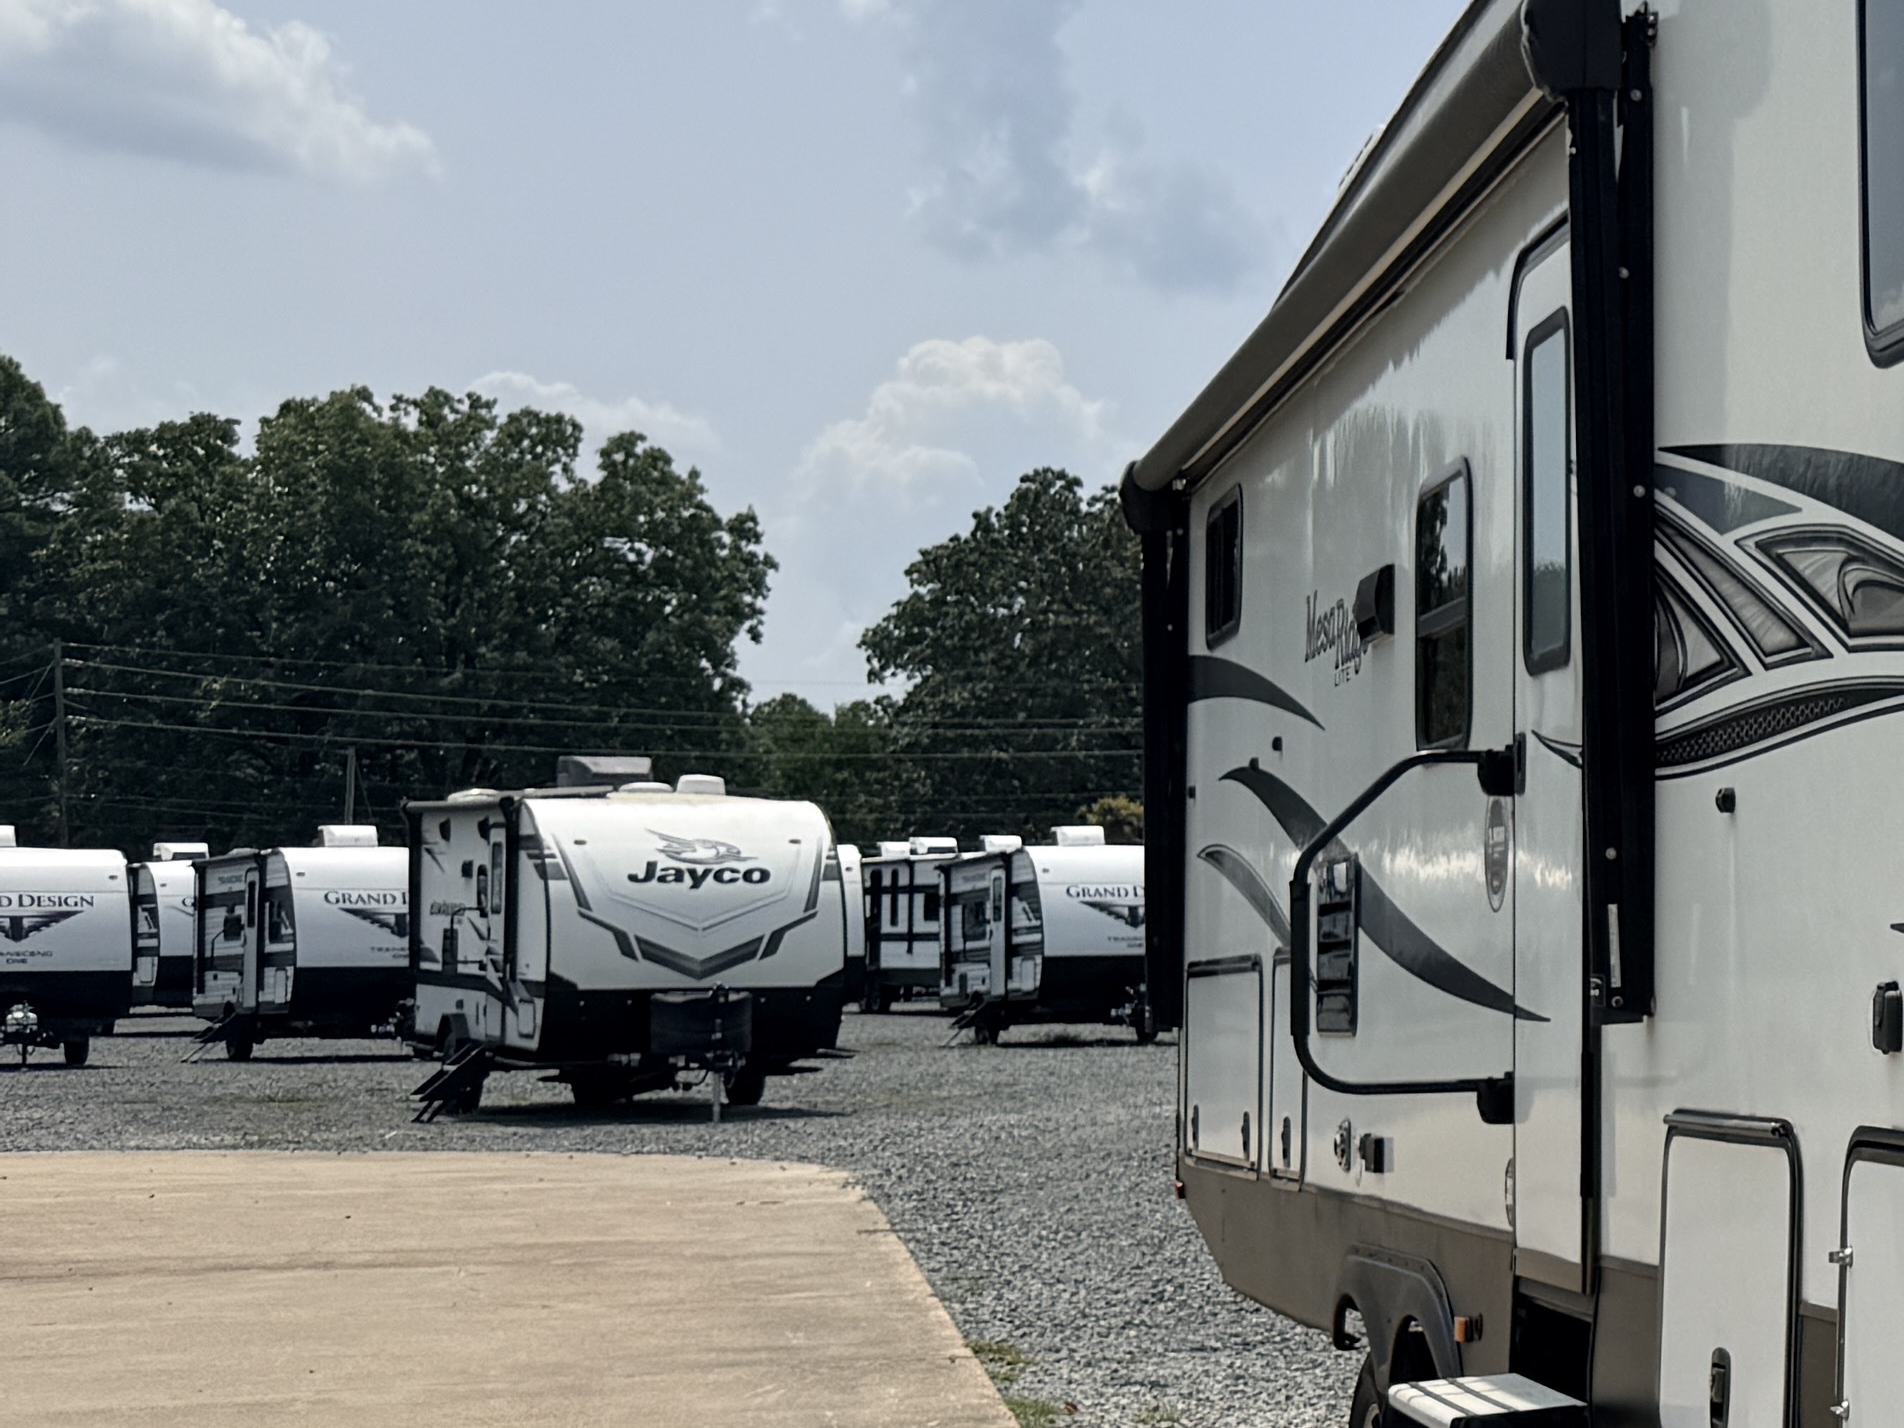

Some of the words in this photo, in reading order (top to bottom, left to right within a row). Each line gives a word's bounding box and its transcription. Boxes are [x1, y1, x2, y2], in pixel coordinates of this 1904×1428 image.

[627, 860, 771, 889] Jayco
[324, 890, 397, 905] GRAND
[1066, 884, 1129, 899] GRAND
[17, 893, 95, 908] DESIGN
